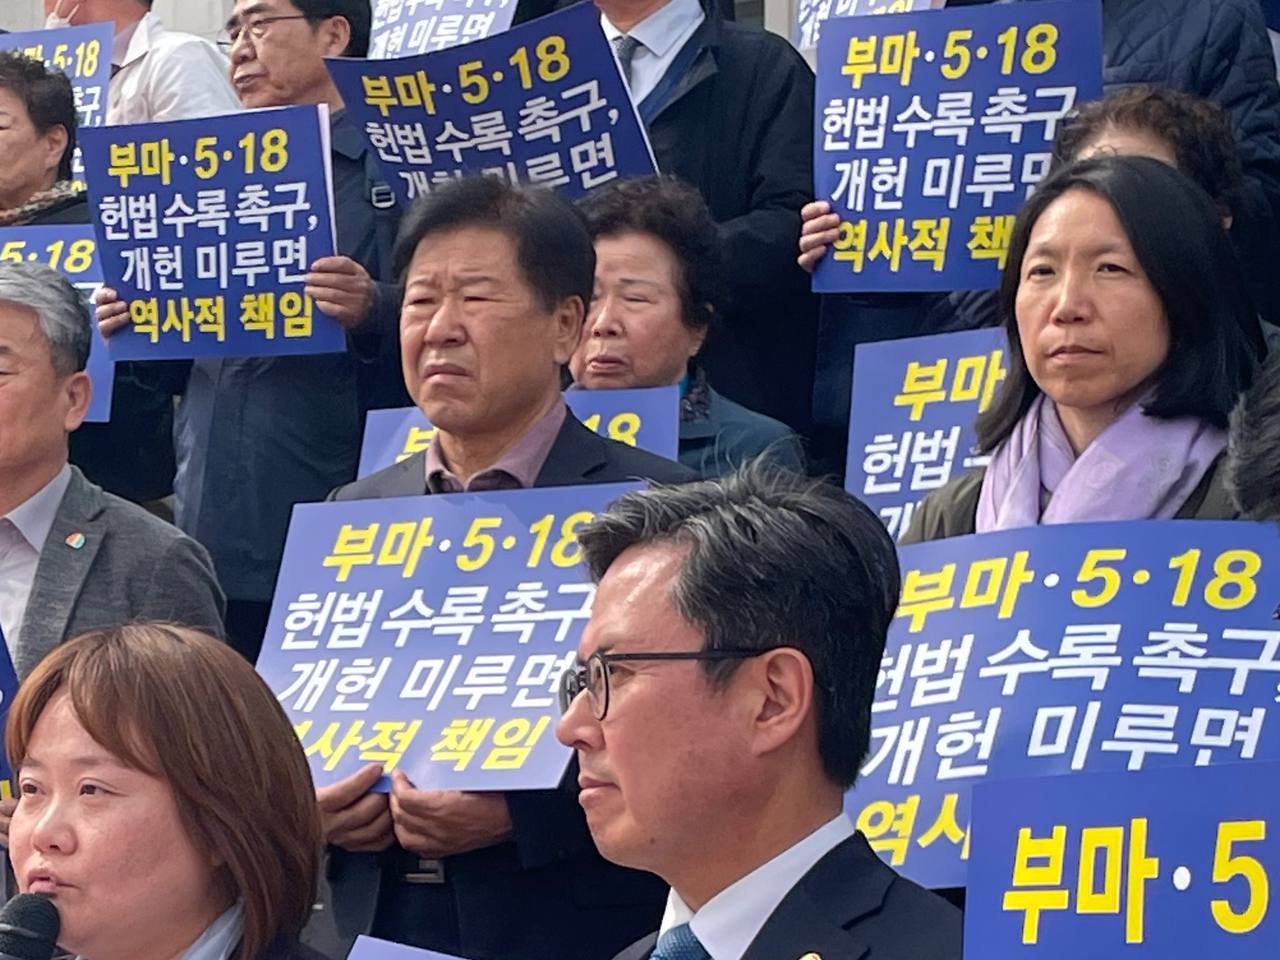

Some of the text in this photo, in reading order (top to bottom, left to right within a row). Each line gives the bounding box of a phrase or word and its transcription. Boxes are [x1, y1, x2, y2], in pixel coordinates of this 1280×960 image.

[361, 35, 570, 117] 부마·5·18
[841, 23, 1058, 89] 부마·5·18
[365, 79, 619, 165] 헌법 수록 촉구,
[823, 95, 890, 151] 헌법
[892, 91, 975, 148] 수록
[108, 128, 290, 189] 부마·5·18
[831, 156, 908, 211] 개헌
[98, 181, 319, 242] 헌법 수록 촉구,
[120, 235, 309, 292] 개헌 미루면
[833, 217, 950, 272] 역사적
[130, 290, 314, 344] 역사적 책임
[322, 510, 594, 582] 부마·5·18
[280, 589, 384, 651] 헌법
[381, 584, 490, 647] 수록
[896, 548, 1263, 633] 부마·5·18
[276, 650, 571, 711] 개헌 미루면
[872, 634, 975, 713] 헌법
[979, 623, 1122, 697] 수록
[292, 715, 550, 773] 사적 책임
[860, 707, 1001, 785] 개헌
